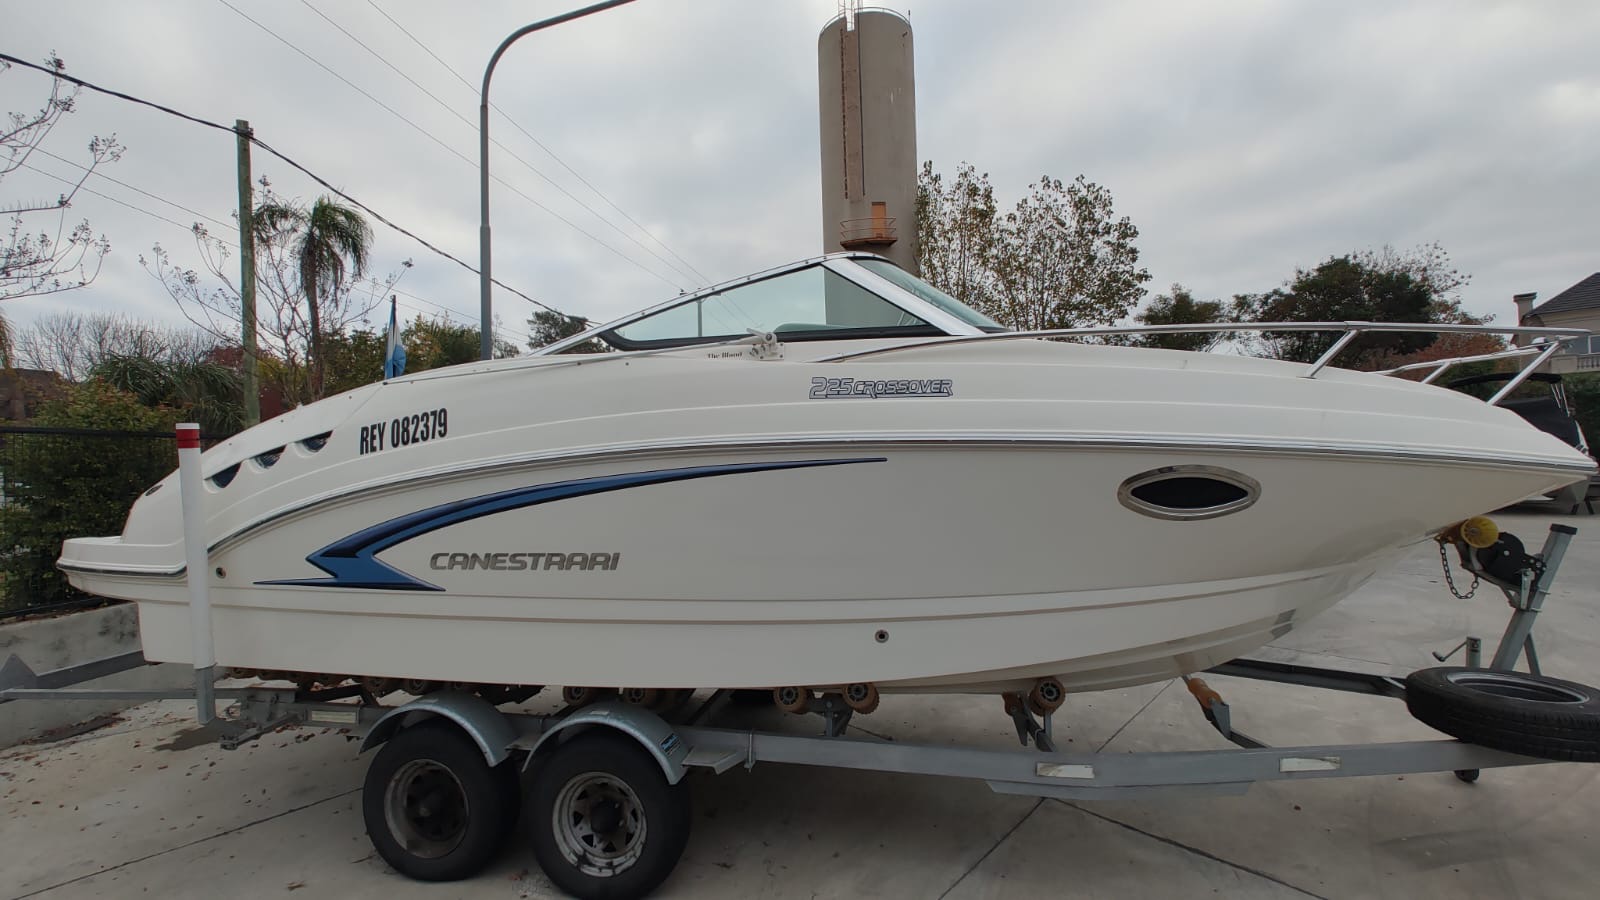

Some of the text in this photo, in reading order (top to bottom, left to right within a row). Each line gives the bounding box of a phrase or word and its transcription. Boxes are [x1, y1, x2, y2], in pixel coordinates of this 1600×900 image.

[360, 408, 447, 455] REY 082379
[430, 553, 620, 570] CANESTRARI
